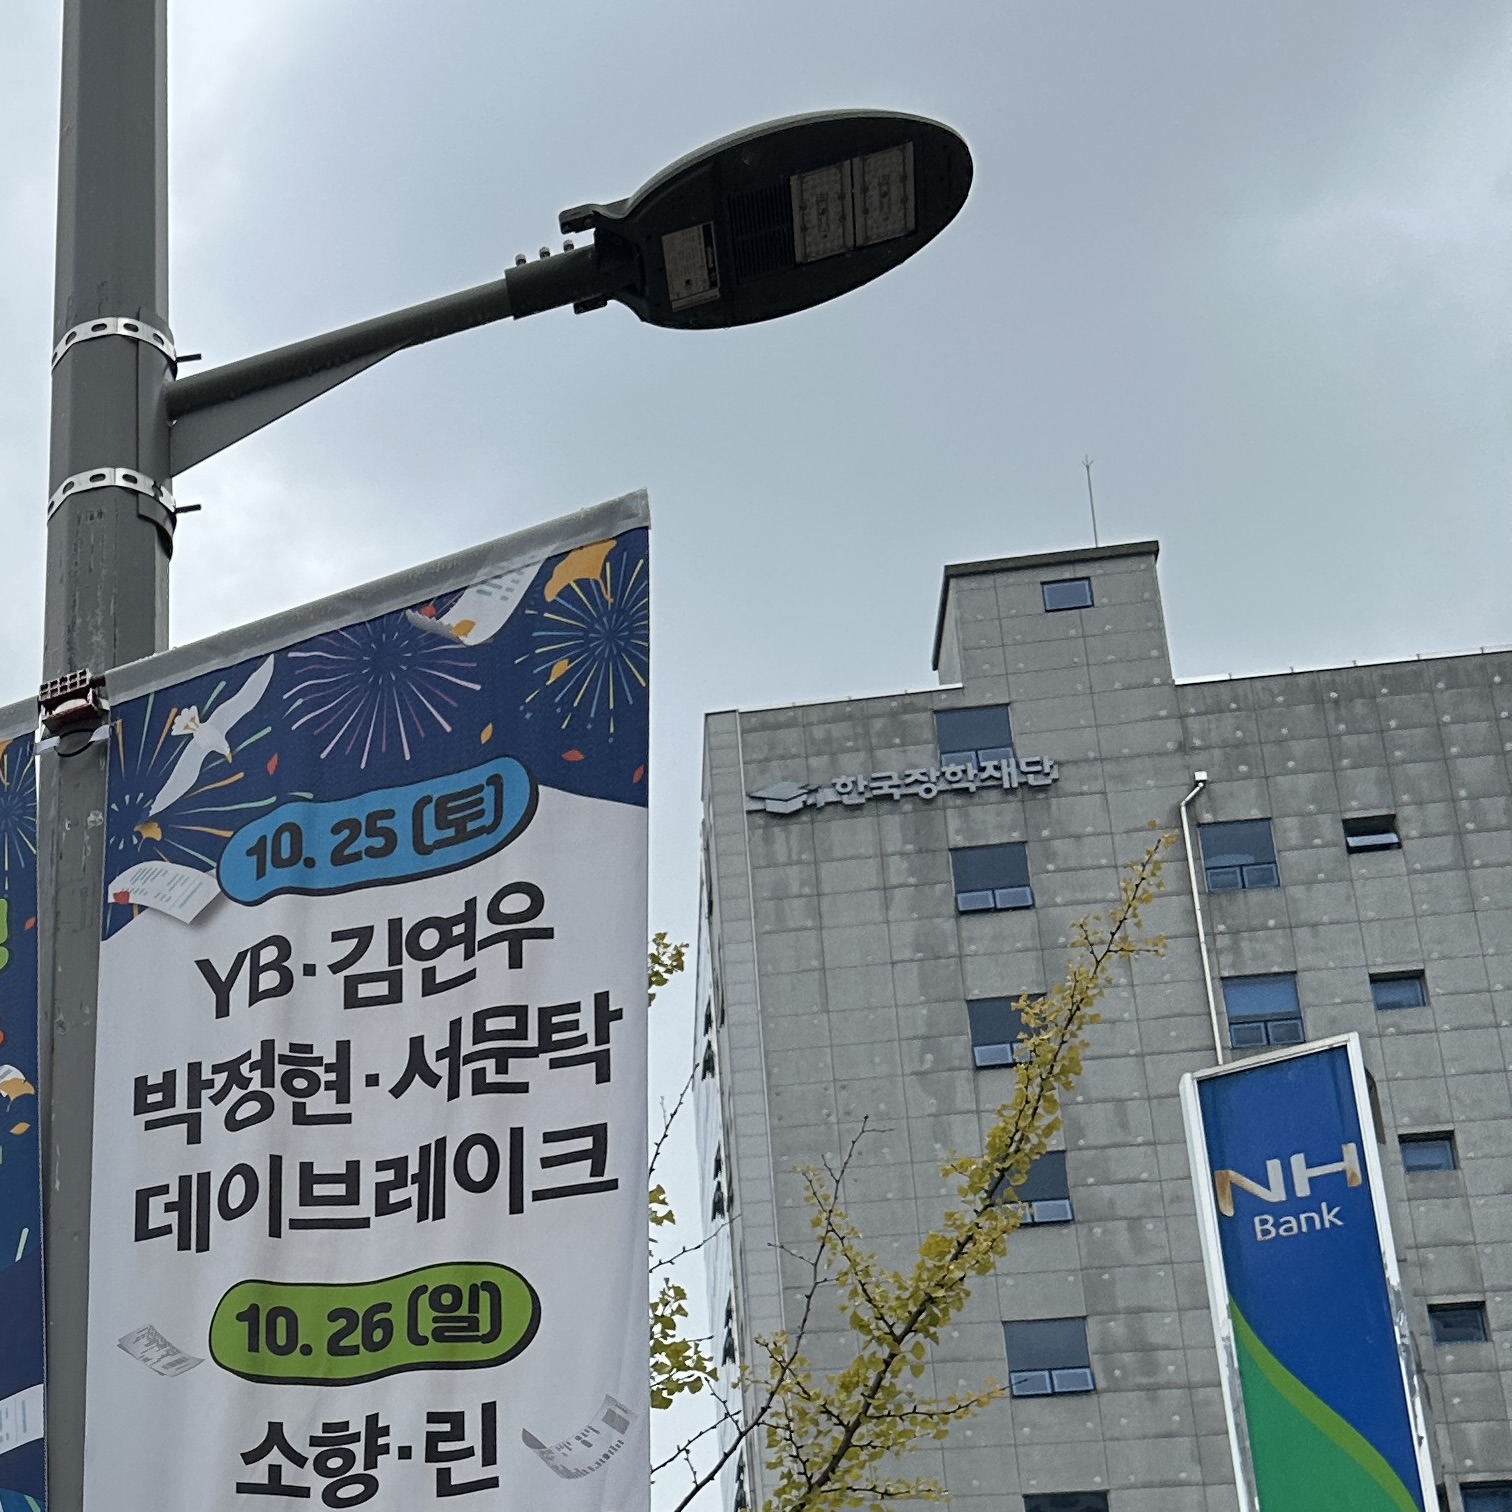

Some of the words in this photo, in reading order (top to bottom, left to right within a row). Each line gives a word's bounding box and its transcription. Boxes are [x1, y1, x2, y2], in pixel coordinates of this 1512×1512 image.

[832, 756, 1060, 806] 한국장학재단
[134, 1121, 619, 1253] 데이브레이크
[1213, 1142, 1362, 1217] NH
[1253, 1201, 1345, 1242] Bank
